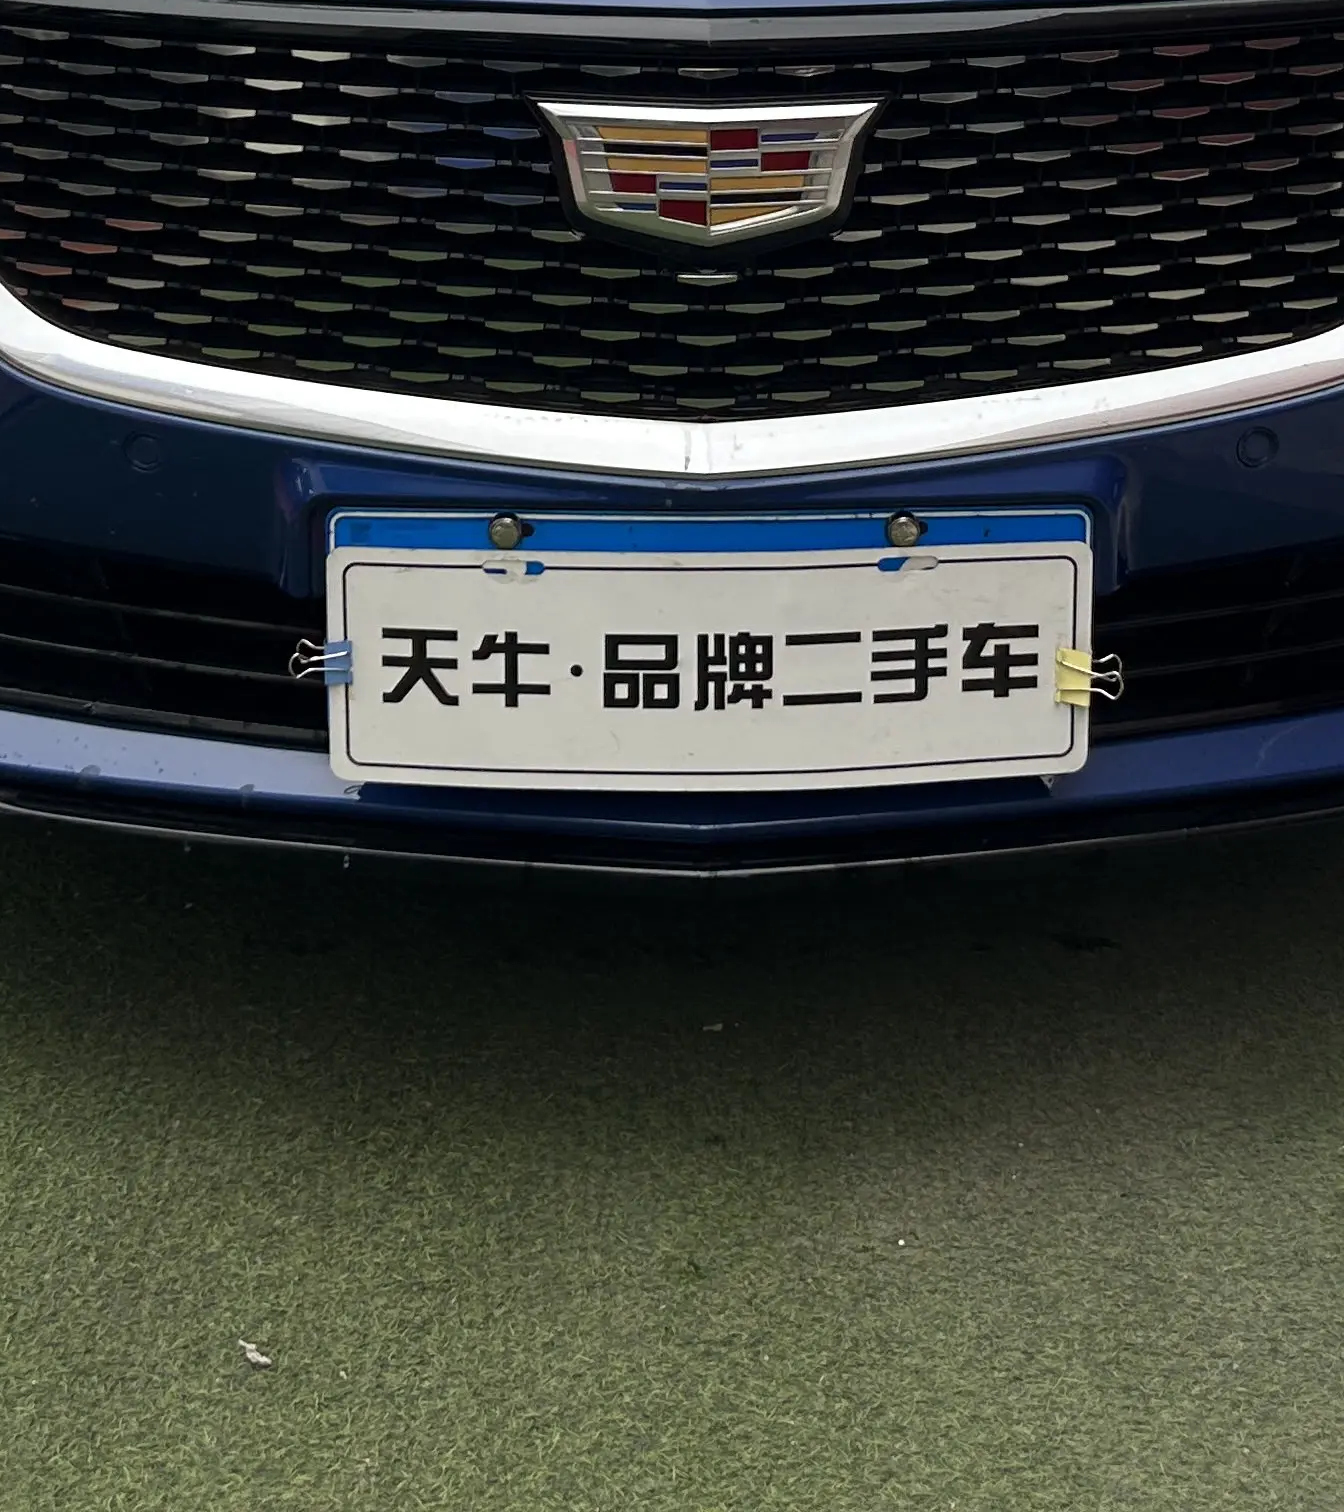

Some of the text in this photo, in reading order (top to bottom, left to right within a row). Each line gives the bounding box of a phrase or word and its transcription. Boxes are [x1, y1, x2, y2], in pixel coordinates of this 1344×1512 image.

[381, 623, 1040, 711] 天牛·品牌二手车
